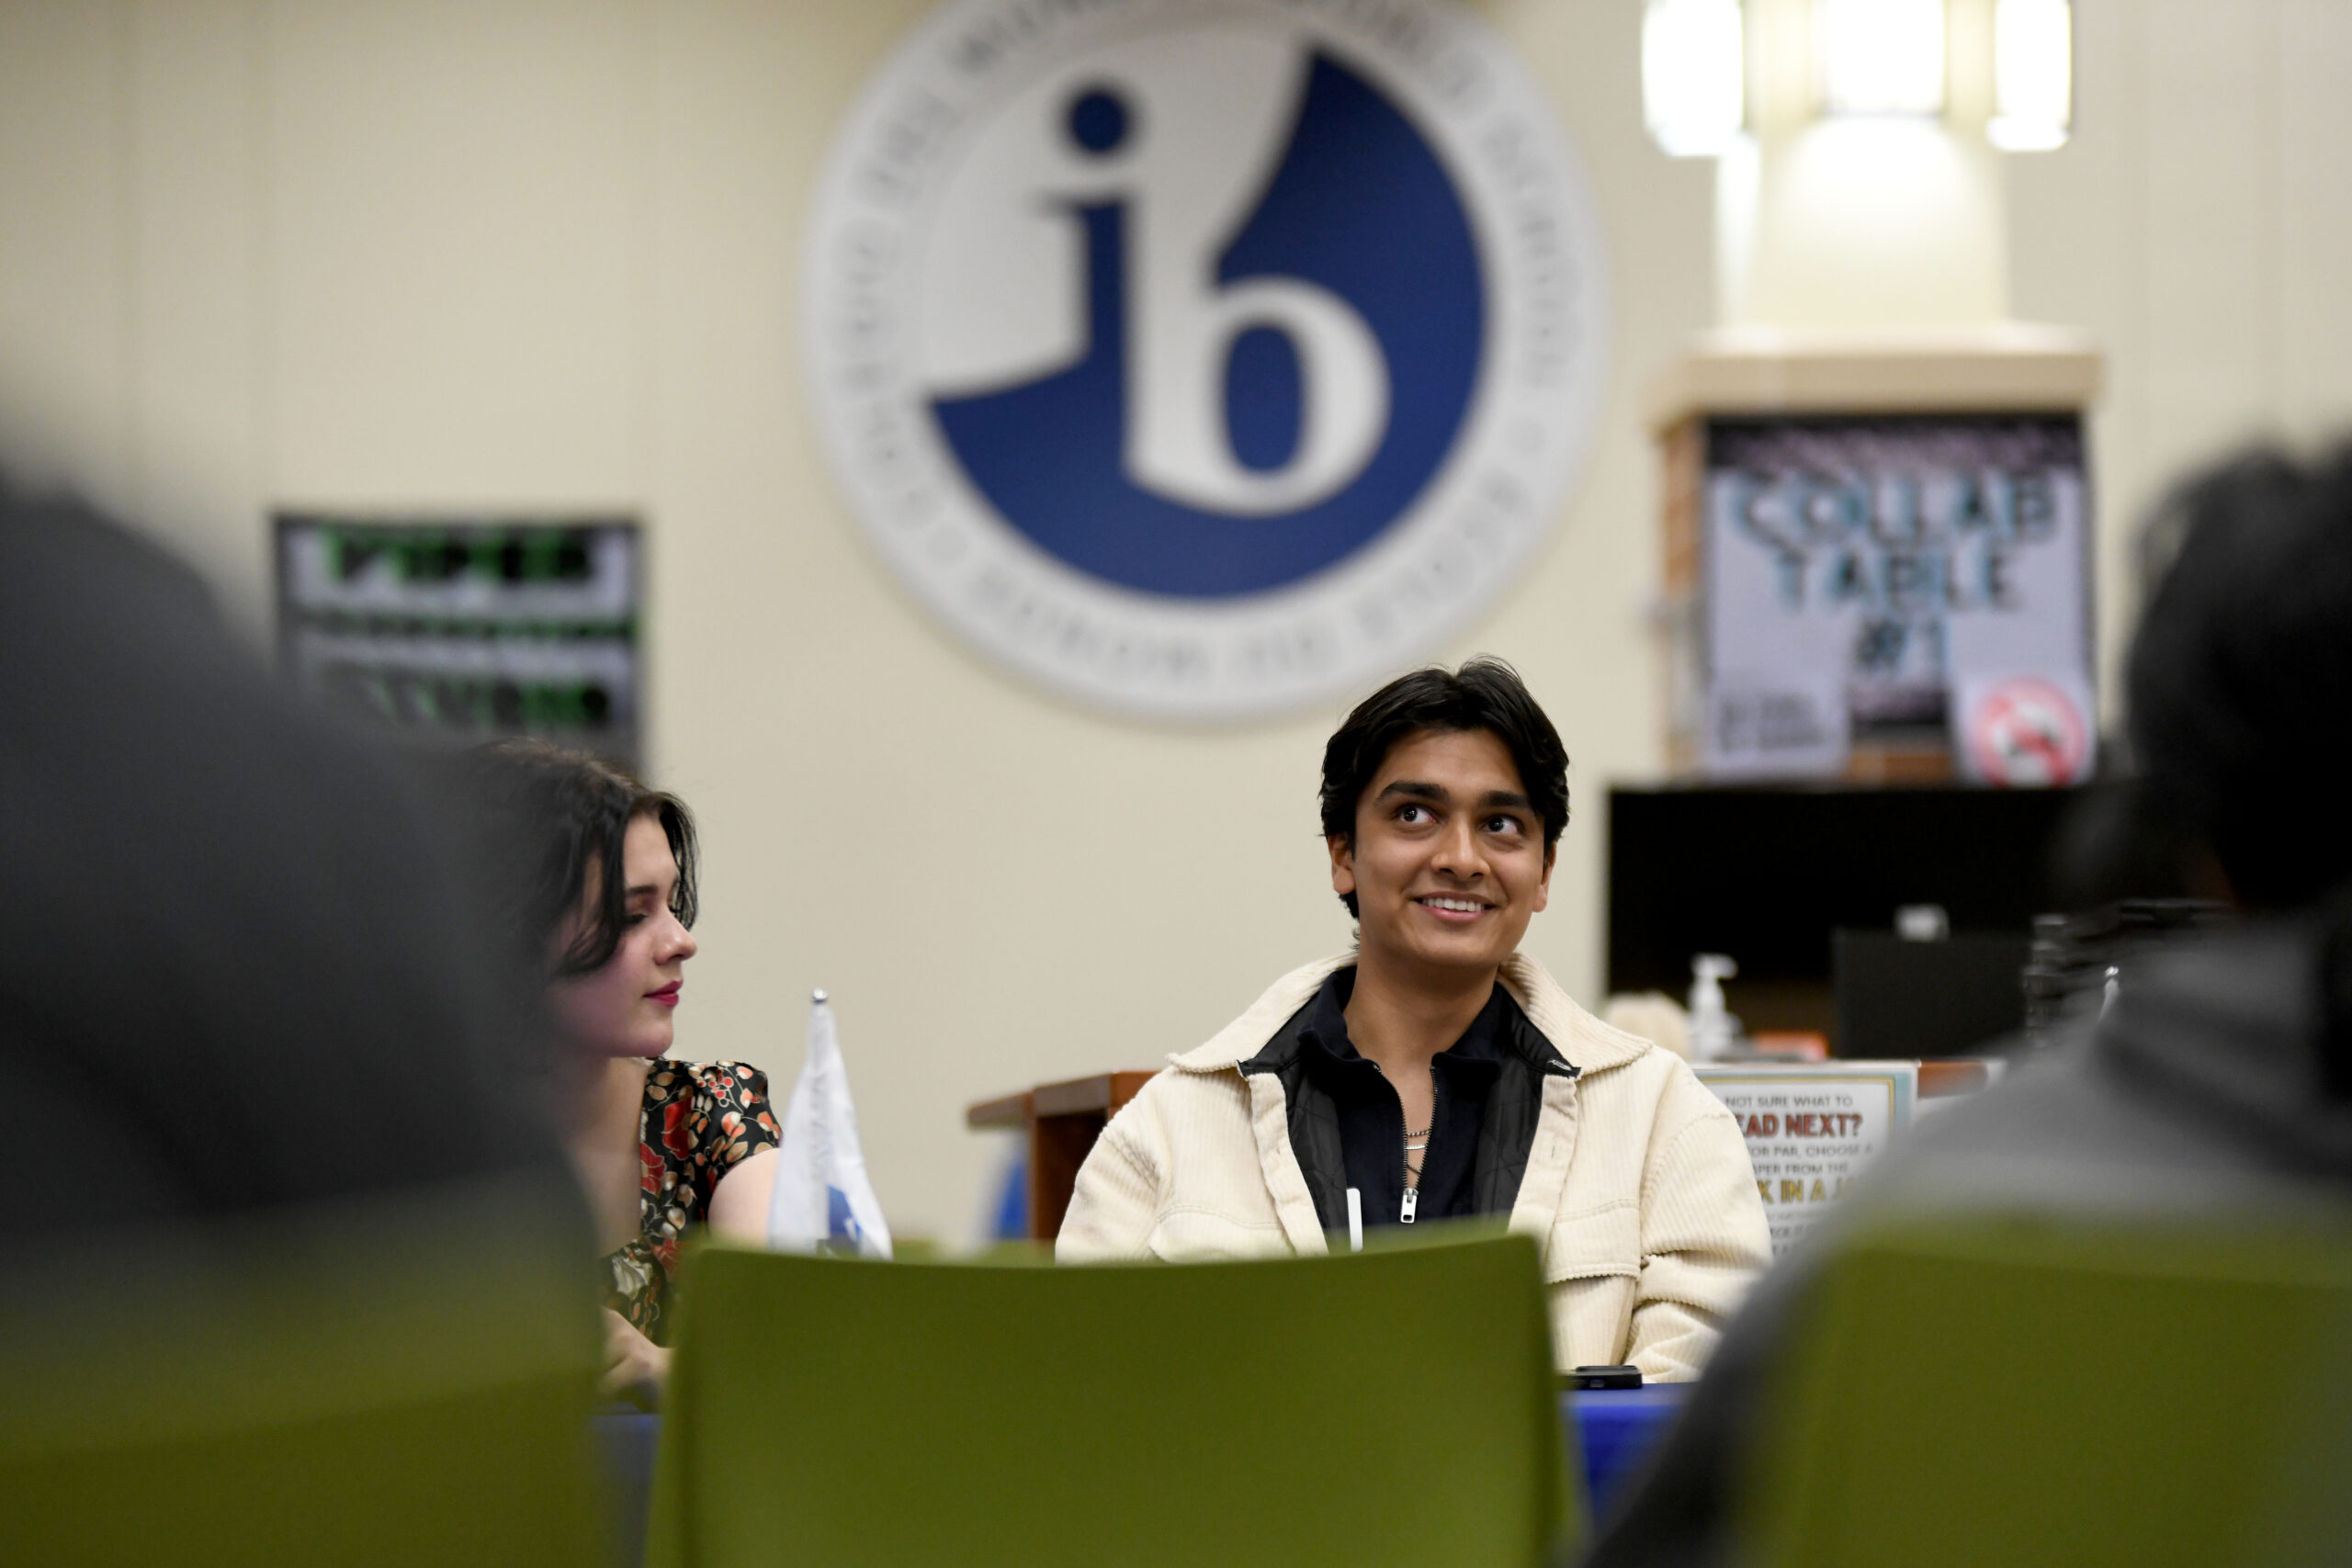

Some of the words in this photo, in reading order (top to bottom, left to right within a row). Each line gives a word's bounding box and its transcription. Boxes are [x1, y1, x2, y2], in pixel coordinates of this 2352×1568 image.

[1730, 474, 2054, 543] COLLAB
[1773, 544, 2021, 610] TABLE
[1855, 614, 1947, 674] #1
[1725, 1096, 1753, 1108] NOT
[1757, 1096, 1789, 1108] SURE
[1793, 1096, 1831, 1108] WHAT
[1835, 1096, 1853, 1108] TO
[1736, 1113, 1780, 1138] EAD
[1785, 1113, 1863, 1138] NEXT?
[1749, 1145, 1770, 1157] OR
[1806, 1145, 1859, 1157] CHOOSE
[1753, 1163, 1781, 1176] APER
[1786, 1163, 1823, 1176] FROM
[1781, 1179, 1804, 1204] IN
[1811, 1179, 1826, 1202] A
